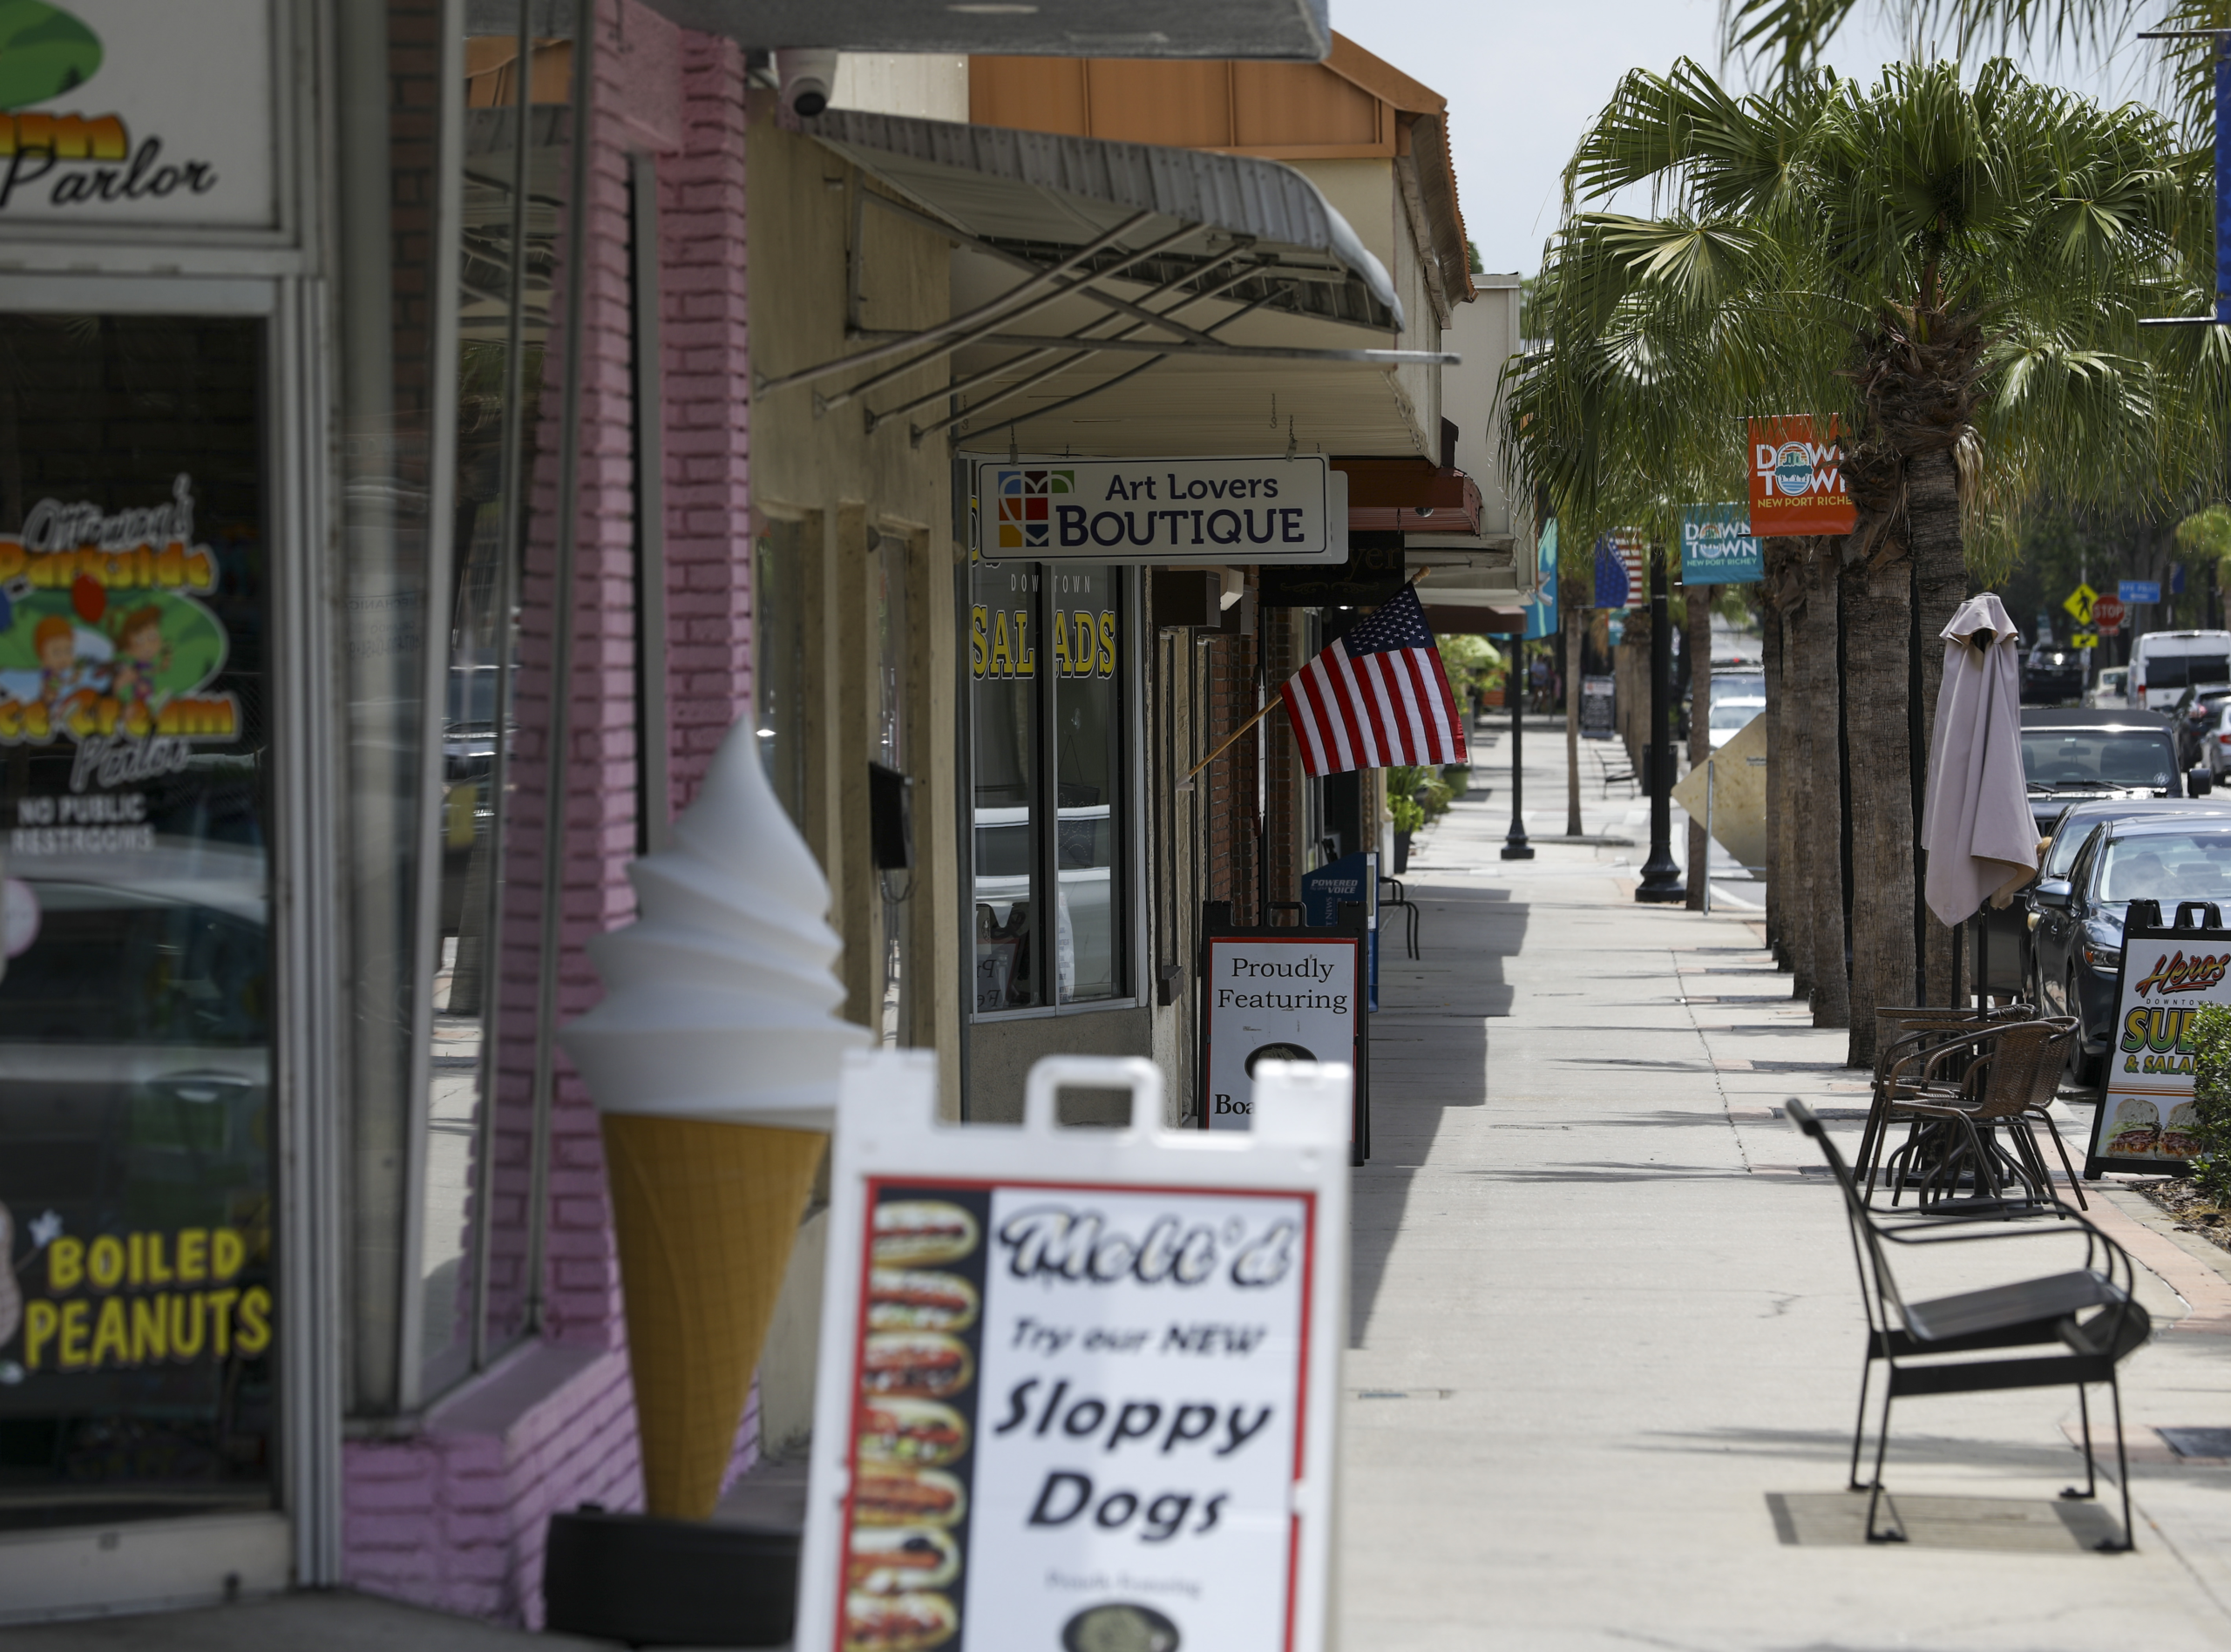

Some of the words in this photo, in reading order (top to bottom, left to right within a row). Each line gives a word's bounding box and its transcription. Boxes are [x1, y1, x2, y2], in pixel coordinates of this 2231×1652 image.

[0, 134, 219, 210] Parlor
[1105, 475, 1156, 501] Art
[1168, 473, 1278, 500] Lovers
[1758, 498, 1783, 508] NEW
[1785, 497, 1814, 507] PORT
[1817, 496, 1853, 505] RICHE
[1685, 538, 1757, 559] TOWN
[1705, 558, 1725, 566] PORT
[1727, 557, 1758, 565] RICHEY
[2093, 604, 2124, 619] STOP
[972, 603, 1116, 680] SALADS
[18, 797, 56, 825] NO
[59, 792, 147, 823] PUBLIC
[11, 822, 156, 855] RESTROOMS
[1231, 957, 1335, 983] Proudly
[2135, 950, 2230, 998] Heros
[1217, 989, 1348, 1014] Featuring
[2124, 1054, 2139, 1073] &
[48, 1227, 247, 1295] BOILED
[24, 1285, 274, 1373] PEANUTS
[1011, 1317, 1073, 1357] Try
[1083, 1328, 1149, 1354] our
[1158, 1322, 1268, 1357] NEW
[992, 1375, 1273, 1460] Sloppy
[1024, 1470, 1231, 1543] Dogs
